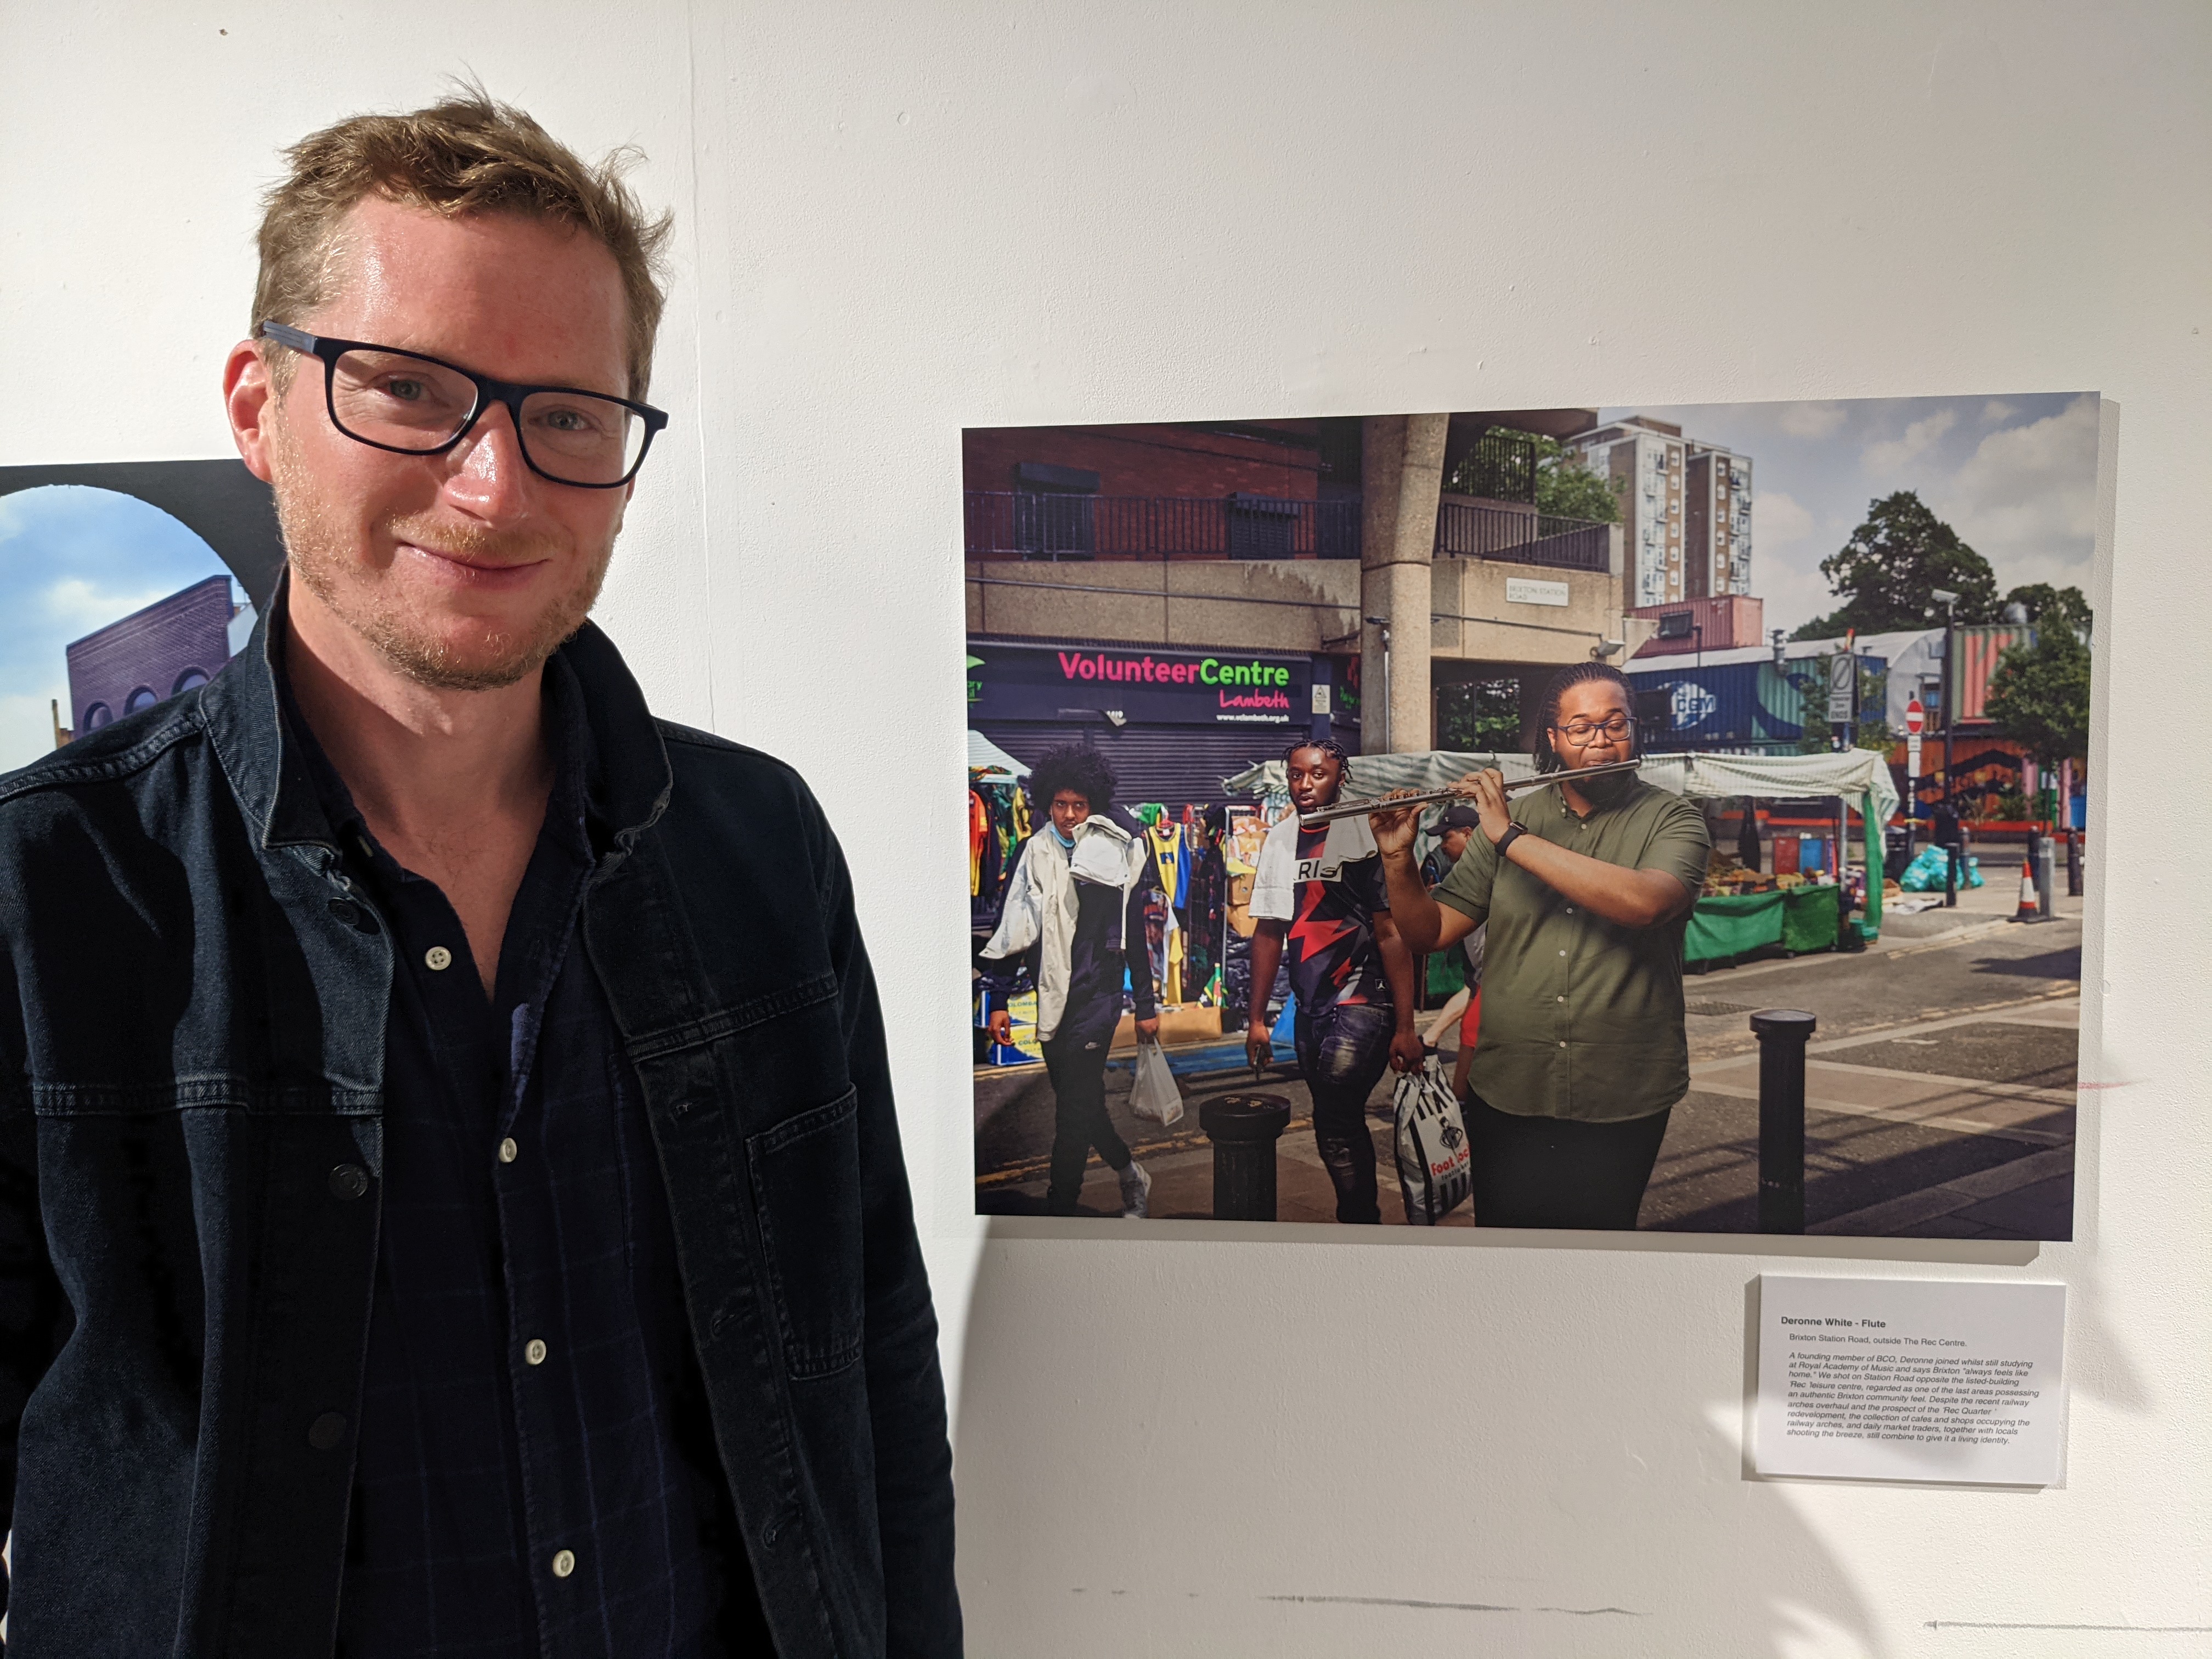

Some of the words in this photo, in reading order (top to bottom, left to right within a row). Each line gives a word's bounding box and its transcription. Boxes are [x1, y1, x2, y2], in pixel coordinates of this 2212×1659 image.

[1058, 652, 1289, 686] VolunteerCentre
[1219, 688, 1290, 708] Lambeth
[1293, 860, 1338, 880] RIS
[1781, 1317, 1821, 1325] Deronne
[1825, 1318, 1852, 1327] White
[1861, 1319, 1886, 1328] Flute
[1819, 1334, 1846, 1342] Station
[1797, 1352, 1831, 1362] founding
[1876, 1355, 1897, 1363] BCO,
[2000, 1360, 2033, 1369] studying
[1798, 1361, 1821, 1370] Royal
[1822, 1363, 1859, 1371] Academy
[1966, 1377, 2019, 1387] listed-building
[1995, 1390, 2039, 1398] possessing
[1929, 1396, 1959, 1404] Despite
[2001, 1399, 2030, 1407] railway
[1787, 1410, 1846, 1420] redevelopment,
[1787, 1420, 1814, 1429] railway
[1787, 1429, 1820, 1438] shooting
[1958, 1436, 1978, 1444] living
[1980, 1436, 2010, 1445] identity.
